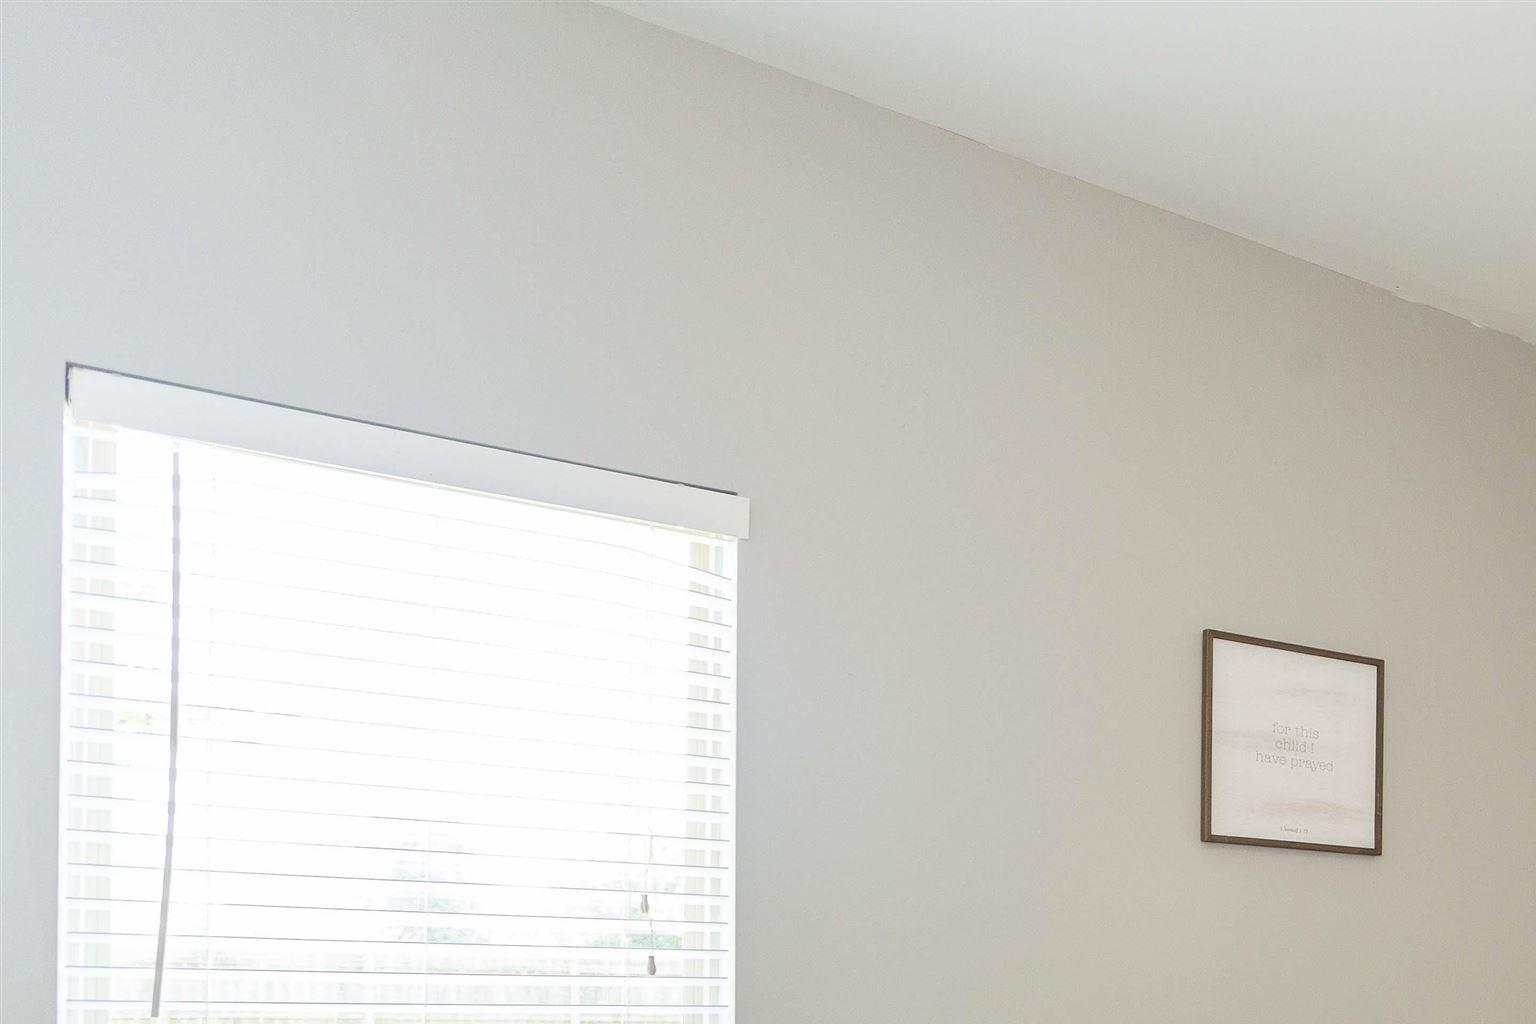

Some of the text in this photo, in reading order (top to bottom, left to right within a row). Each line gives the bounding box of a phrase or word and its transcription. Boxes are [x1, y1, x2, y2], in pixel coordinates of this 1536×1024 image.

[1272, 721, 1320, 740] for this
[1274, 738, 1307, 753] child
[1255, 750, 1335, 773] have prayed
